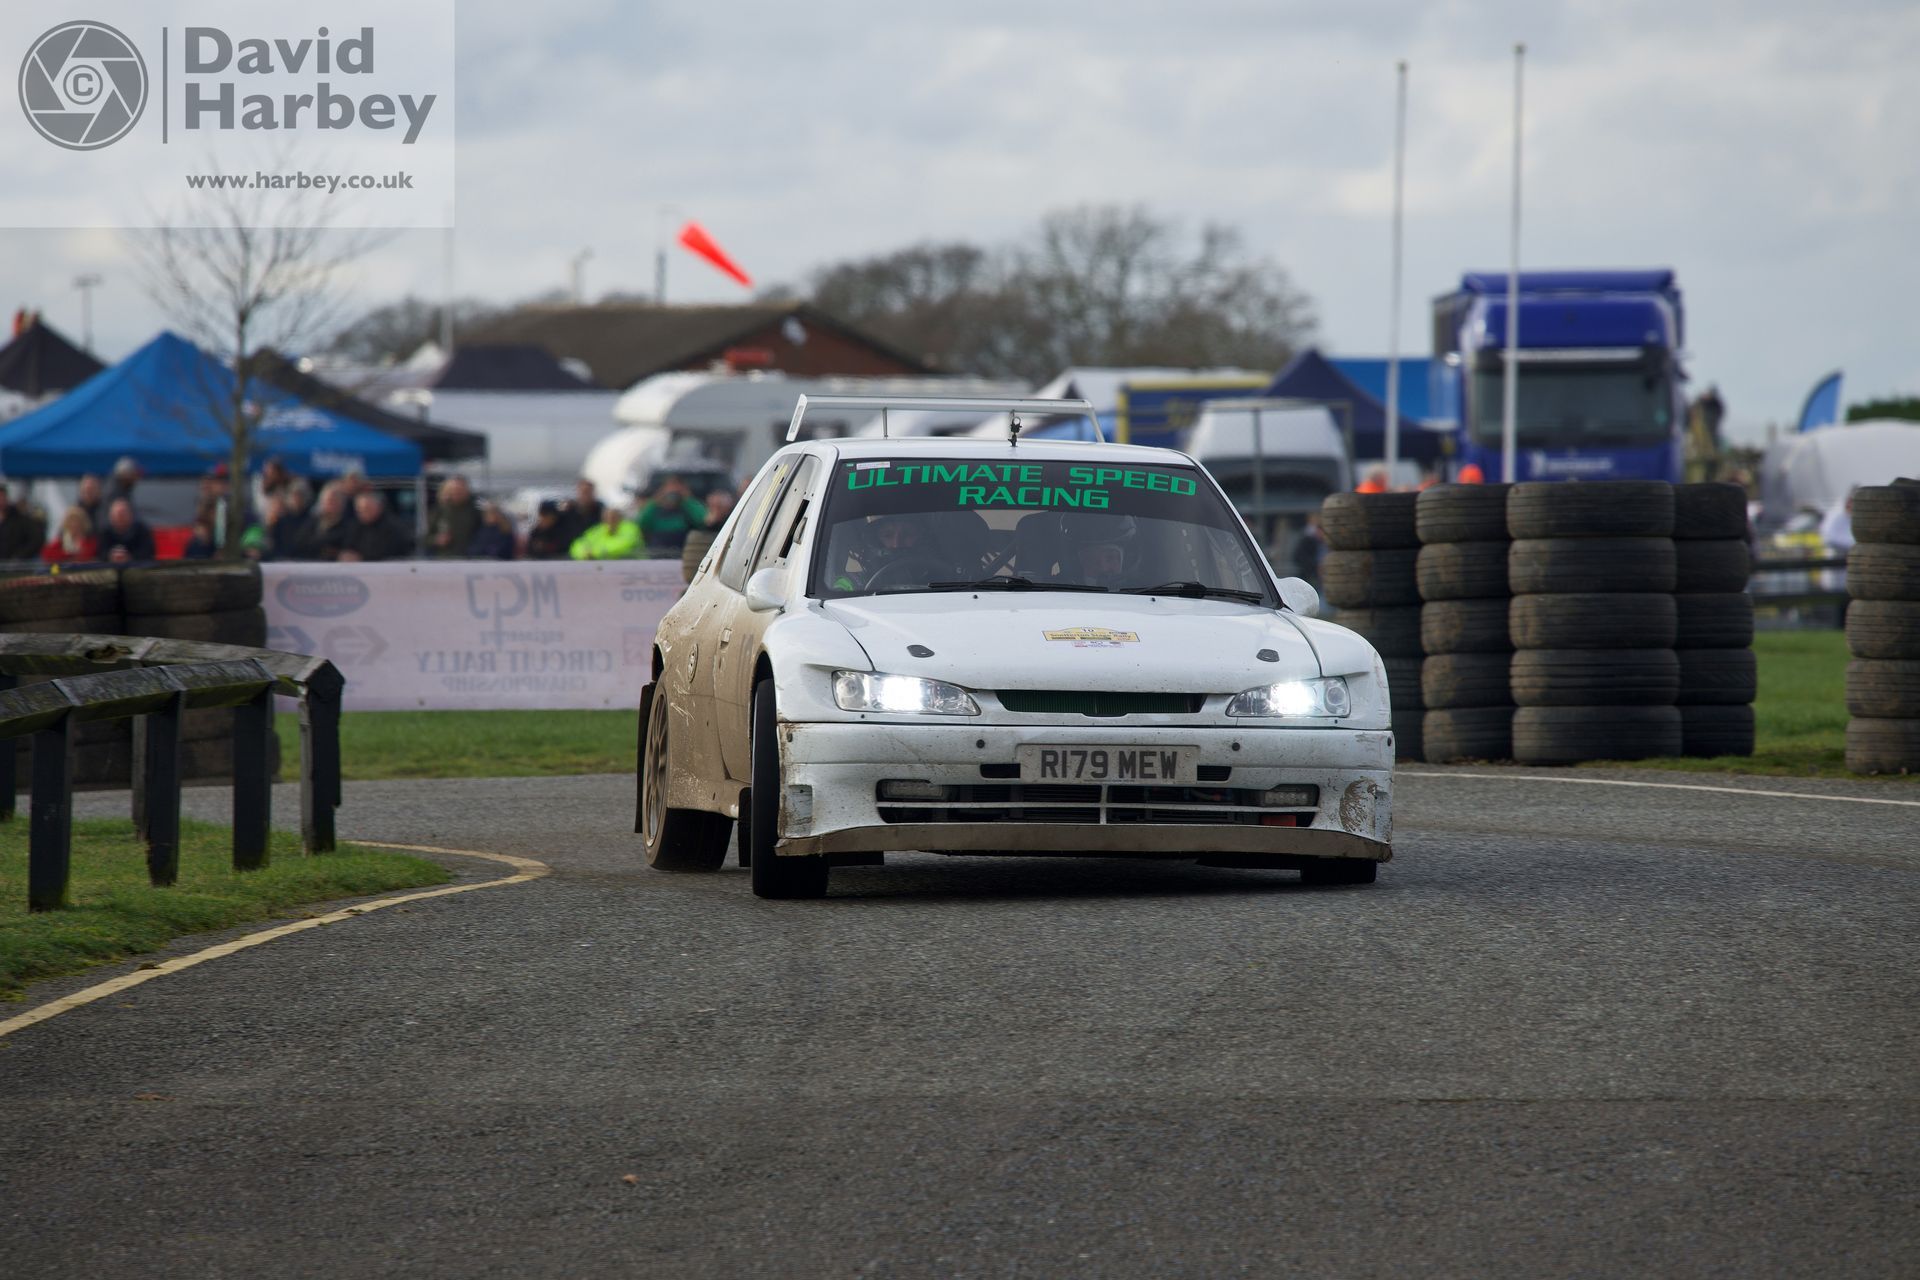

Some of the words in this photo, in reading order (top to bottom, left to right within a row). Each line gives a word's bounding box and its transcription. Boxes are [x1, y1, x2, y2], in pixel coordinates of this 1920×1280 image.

[847, 463, 1043, 491] ULTIMATE
[1069, 467, 1197, 497] SPEED
[957, 486, 1110, 510] RACING
[1041, 750, 1108, 778] R179
[1118, 751, 1178, 779] MEW
